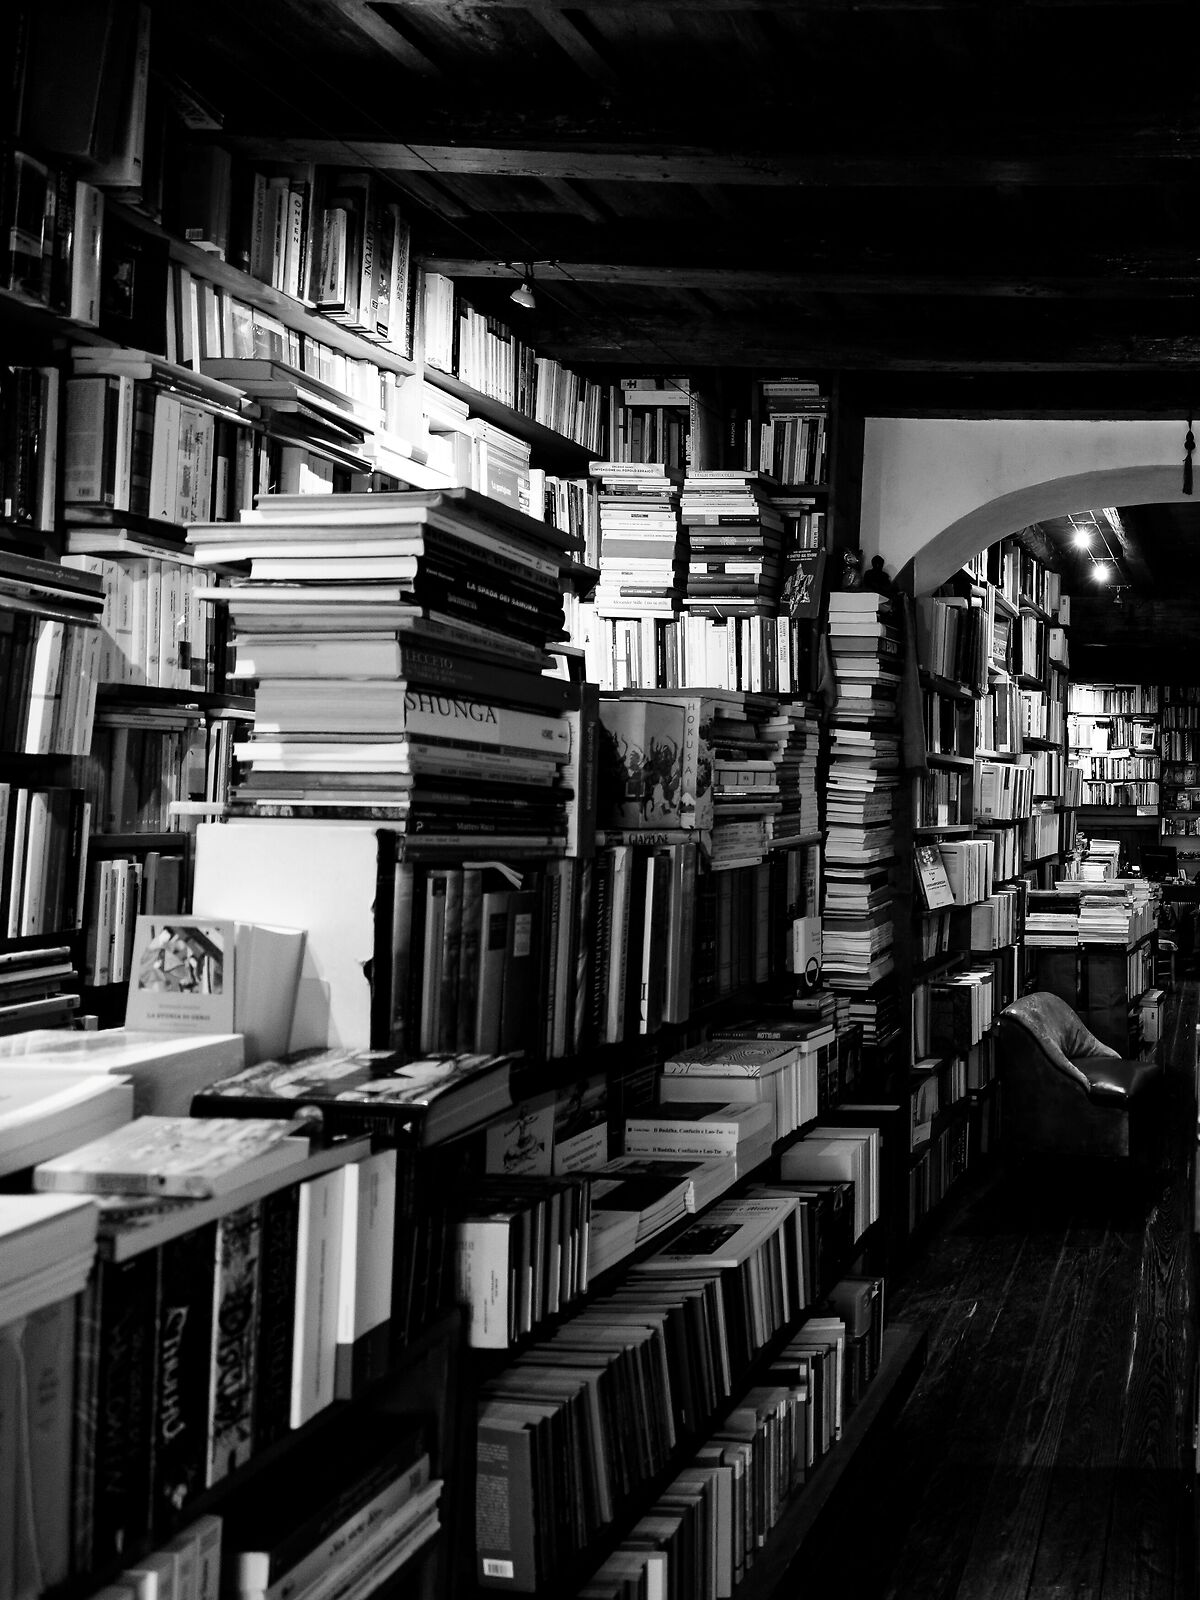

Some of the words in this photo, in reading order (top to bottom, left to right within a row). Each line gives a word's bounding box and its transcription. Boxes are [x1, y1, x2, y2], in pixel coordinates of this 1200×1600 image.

[466, 581, 476, 591] LA
[477, 585, 499, 599] SPADA
[500, 594, 510, 603] DEI
[511, 599, 539, 614] SAMURAI
[405, 691, 498, 724] SHUNGA
[686, 703, 695, 788] HOKUSAI
[628, 833, 669, 845] GIAPPONE
